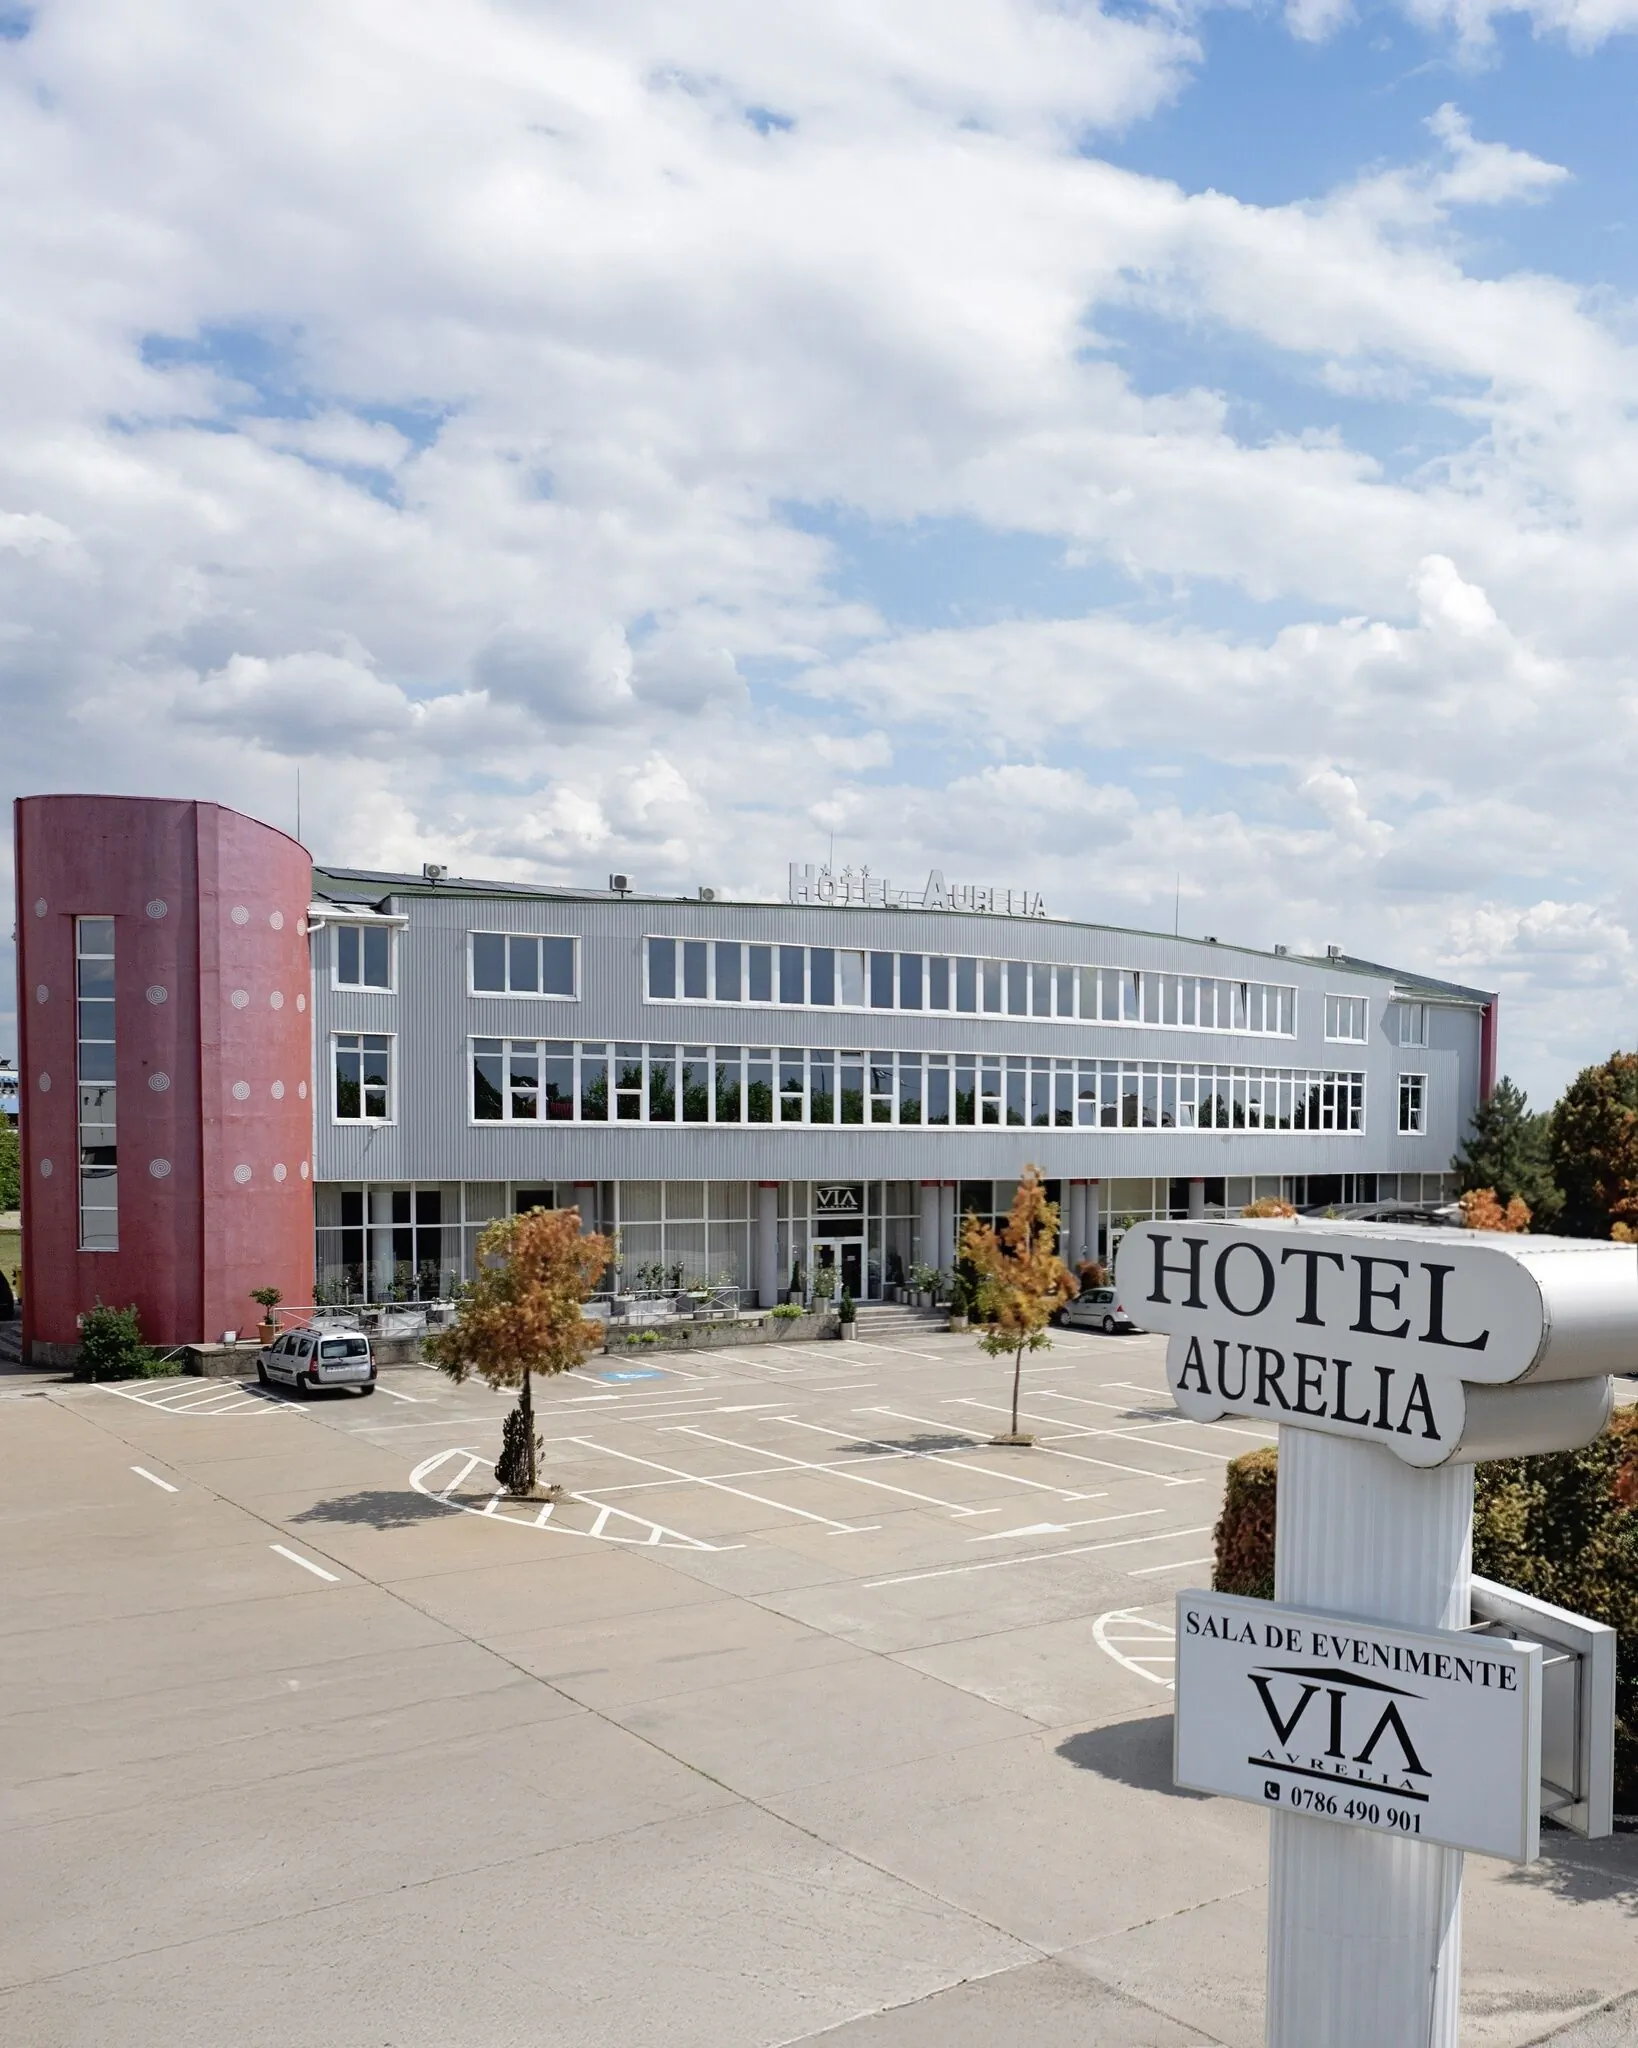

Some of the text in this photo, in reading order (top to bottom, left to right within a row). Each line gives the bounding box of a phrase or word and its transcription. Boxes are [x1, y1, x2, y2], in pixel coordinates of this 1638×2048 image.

[788, 862, 1049, 917] HOTEL AURELIA
[1146, 1233, 1490, 1351] HOTEL
[1177, 1336, 1441, 1440] AURELIA
[1186, 1611, 1517, 1692] SALA DE EVENIMENTE
[1247, 1673, 1433, 1778] VIA
[1261, 1749, 1415, 1791] AVRELIA
[1290, 1787, 1421, 1834] 0786 490 901
